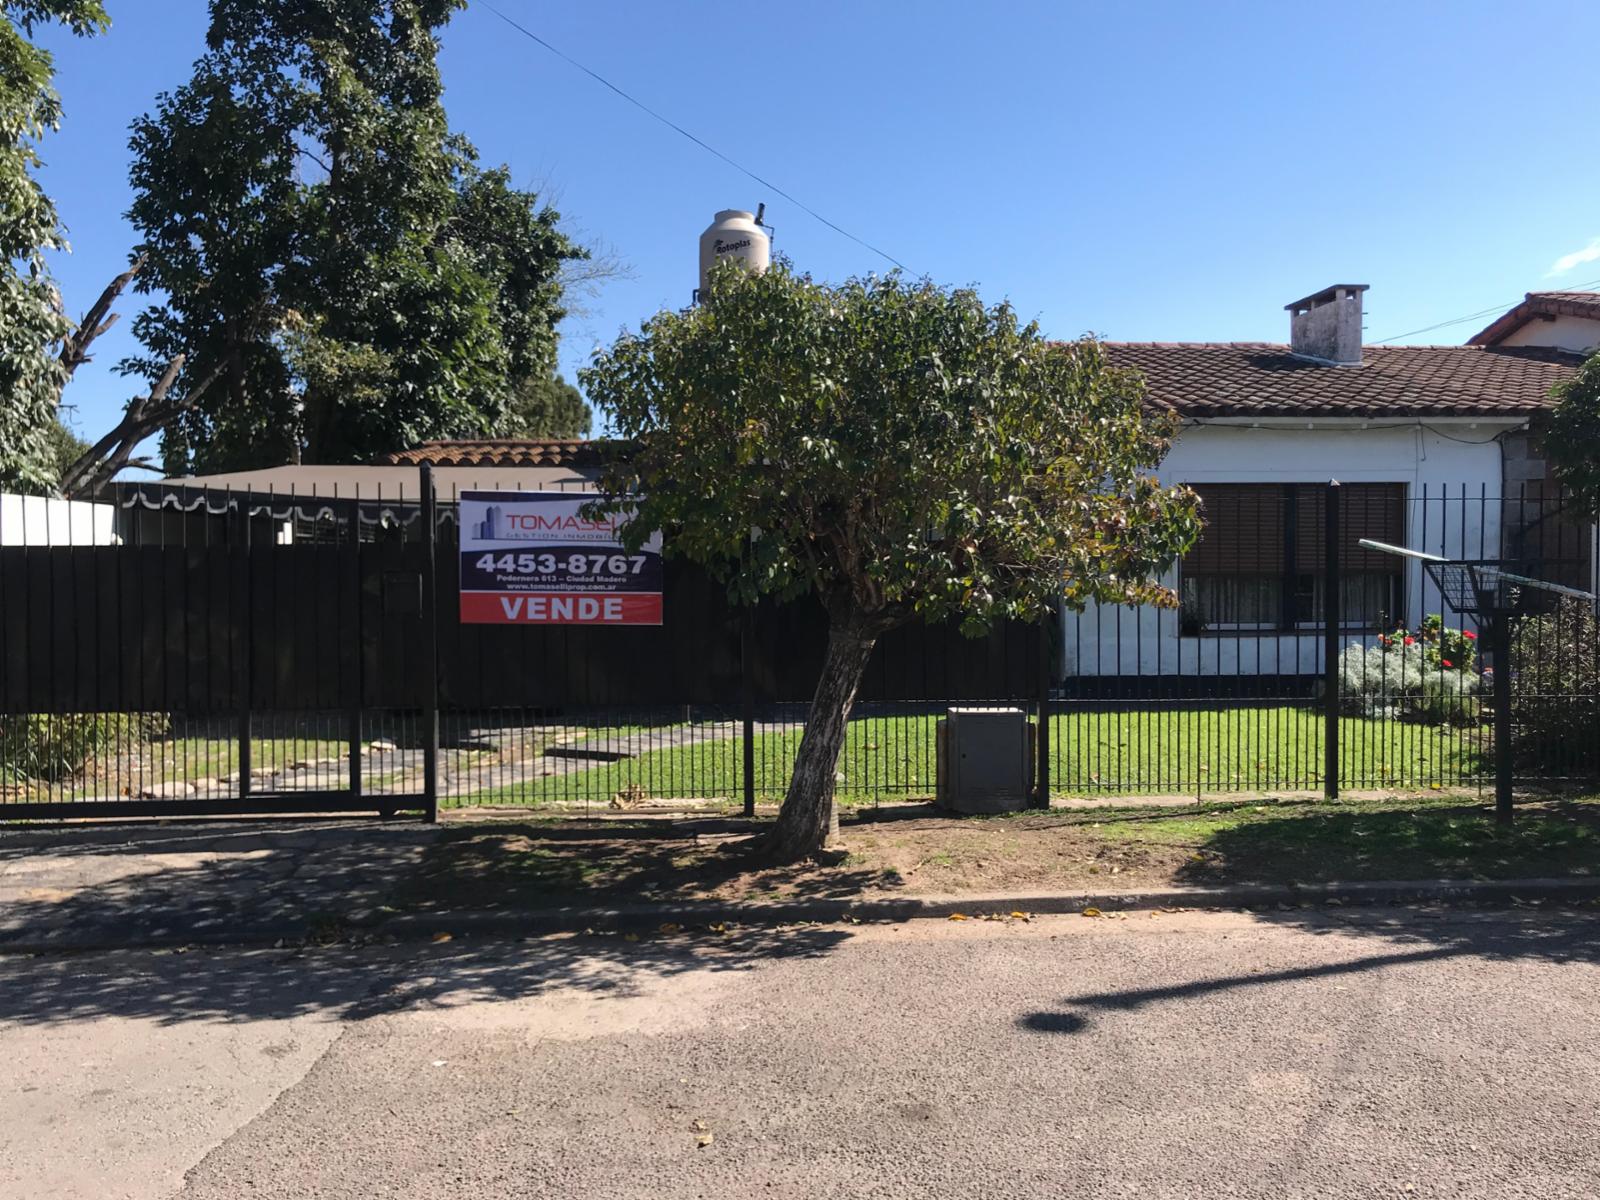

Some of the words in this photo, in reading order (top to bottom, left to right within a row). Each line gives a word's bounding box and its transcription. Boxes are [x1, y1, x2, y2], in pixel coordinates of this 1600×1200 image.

[716, 239, 751, 254] Rotoplas
[476, 553, 647, 574] 4453-8767
[566, 575, 595, 583] Ciudad
[596, 575, 627, 583] Madero
[507, 583, 617, 591] www.tomaselliprop.com.ar
[500, 597, 623, 620] VENDE
